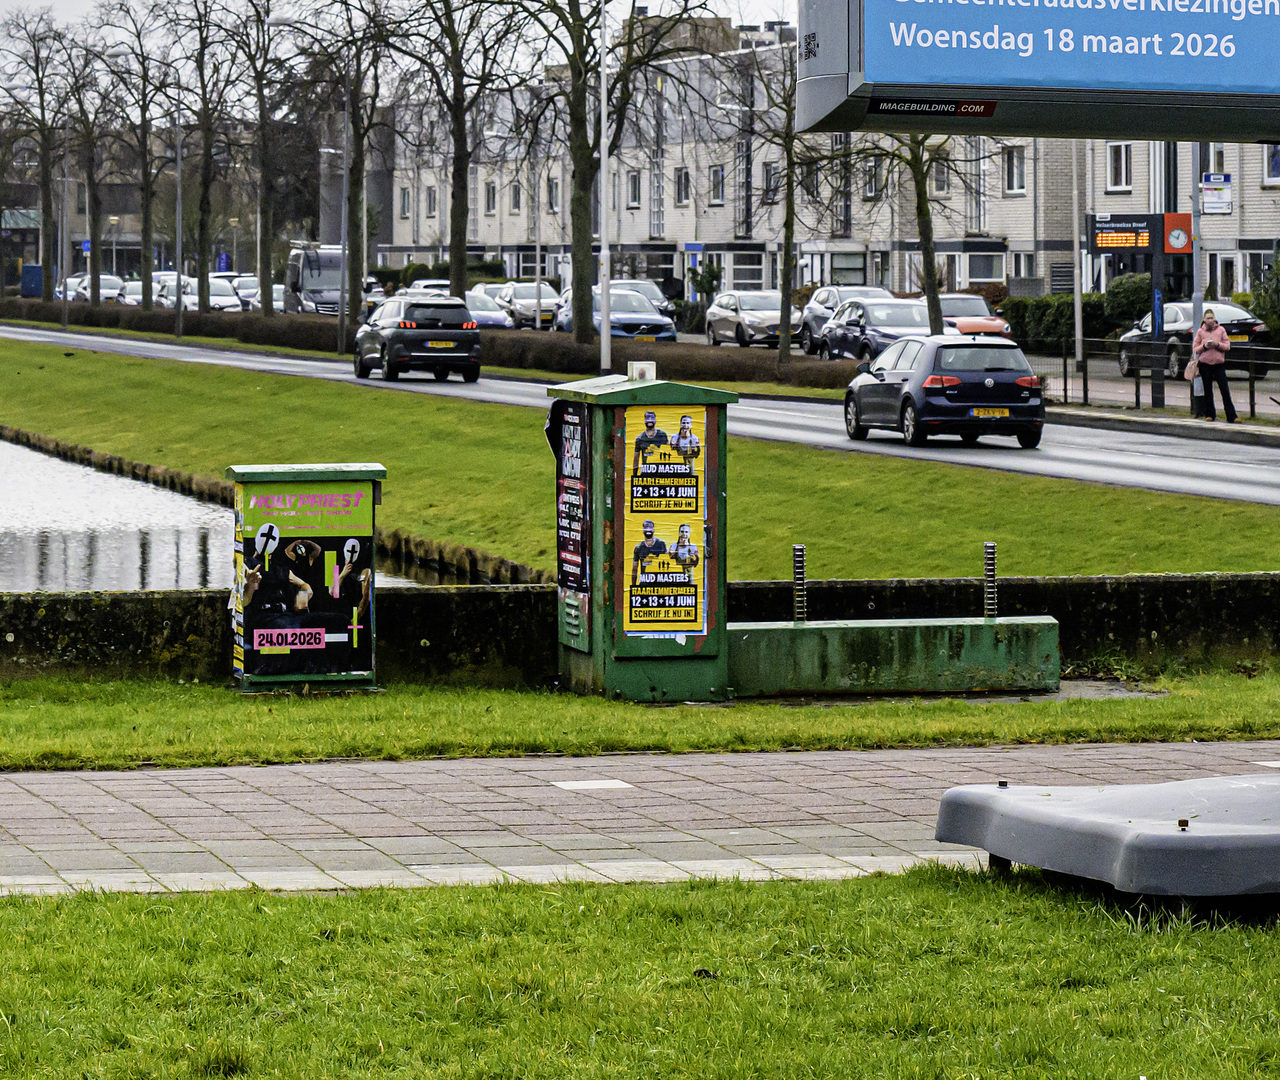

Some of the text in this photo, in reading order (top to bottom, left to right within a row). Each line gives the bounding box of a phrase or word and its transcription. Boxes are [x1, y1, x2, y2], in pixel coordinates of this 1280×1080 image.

[889, 22, 1236, 58] Woensdag 18 maart 2026
[640, 464, 690, 473] MUD MASTERS
[633, 477, 696, 486] HAARLEMMERMEER
[632, 486, 642, 497] 12
[649, 486, 659, 497] 13
[665, 486, 676, 497] 14
[677, 486, 696, 497] JUNI
[249, 494, 297, 509] HOLY
[639, 573, 689, 583] MUD MASTERS
[632, 586, 695, 595] HAARLEMMERMEER
[631, 595, 641, 607] 12
[648, 595, 658, 607] 13
[664, 595, 674, 607] 14
[677, 595, 695, 607] JUNI
[633, 609, 662, 618] SCHRIJF
[663, 610, 670, 618] JE
[672, 610, 681, 618] NU
[258, 631, 322, 646] 24.01.2026
